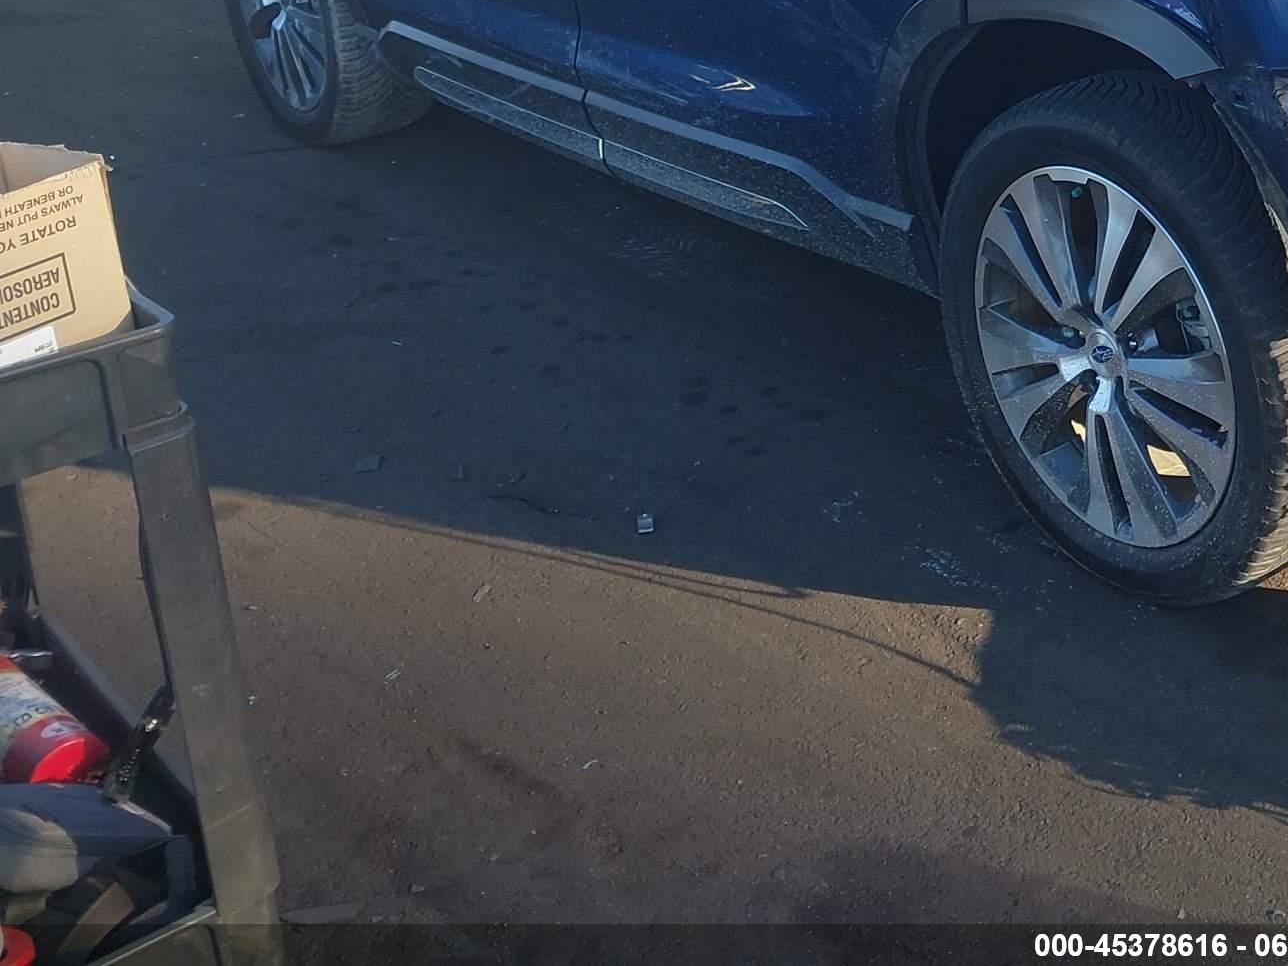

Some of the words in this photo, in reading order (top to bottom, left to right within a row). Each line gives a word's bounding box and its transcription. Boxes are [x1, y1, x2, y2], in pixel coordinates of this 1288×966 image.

[57, 185, 74, 198] OR
[5, 191, 56, 217] BENEATH
[41, 193, 84, 217] ALWAYS
[17, 210, 39, 226] PUT
[19, 215, 77, 246] ROTATE
